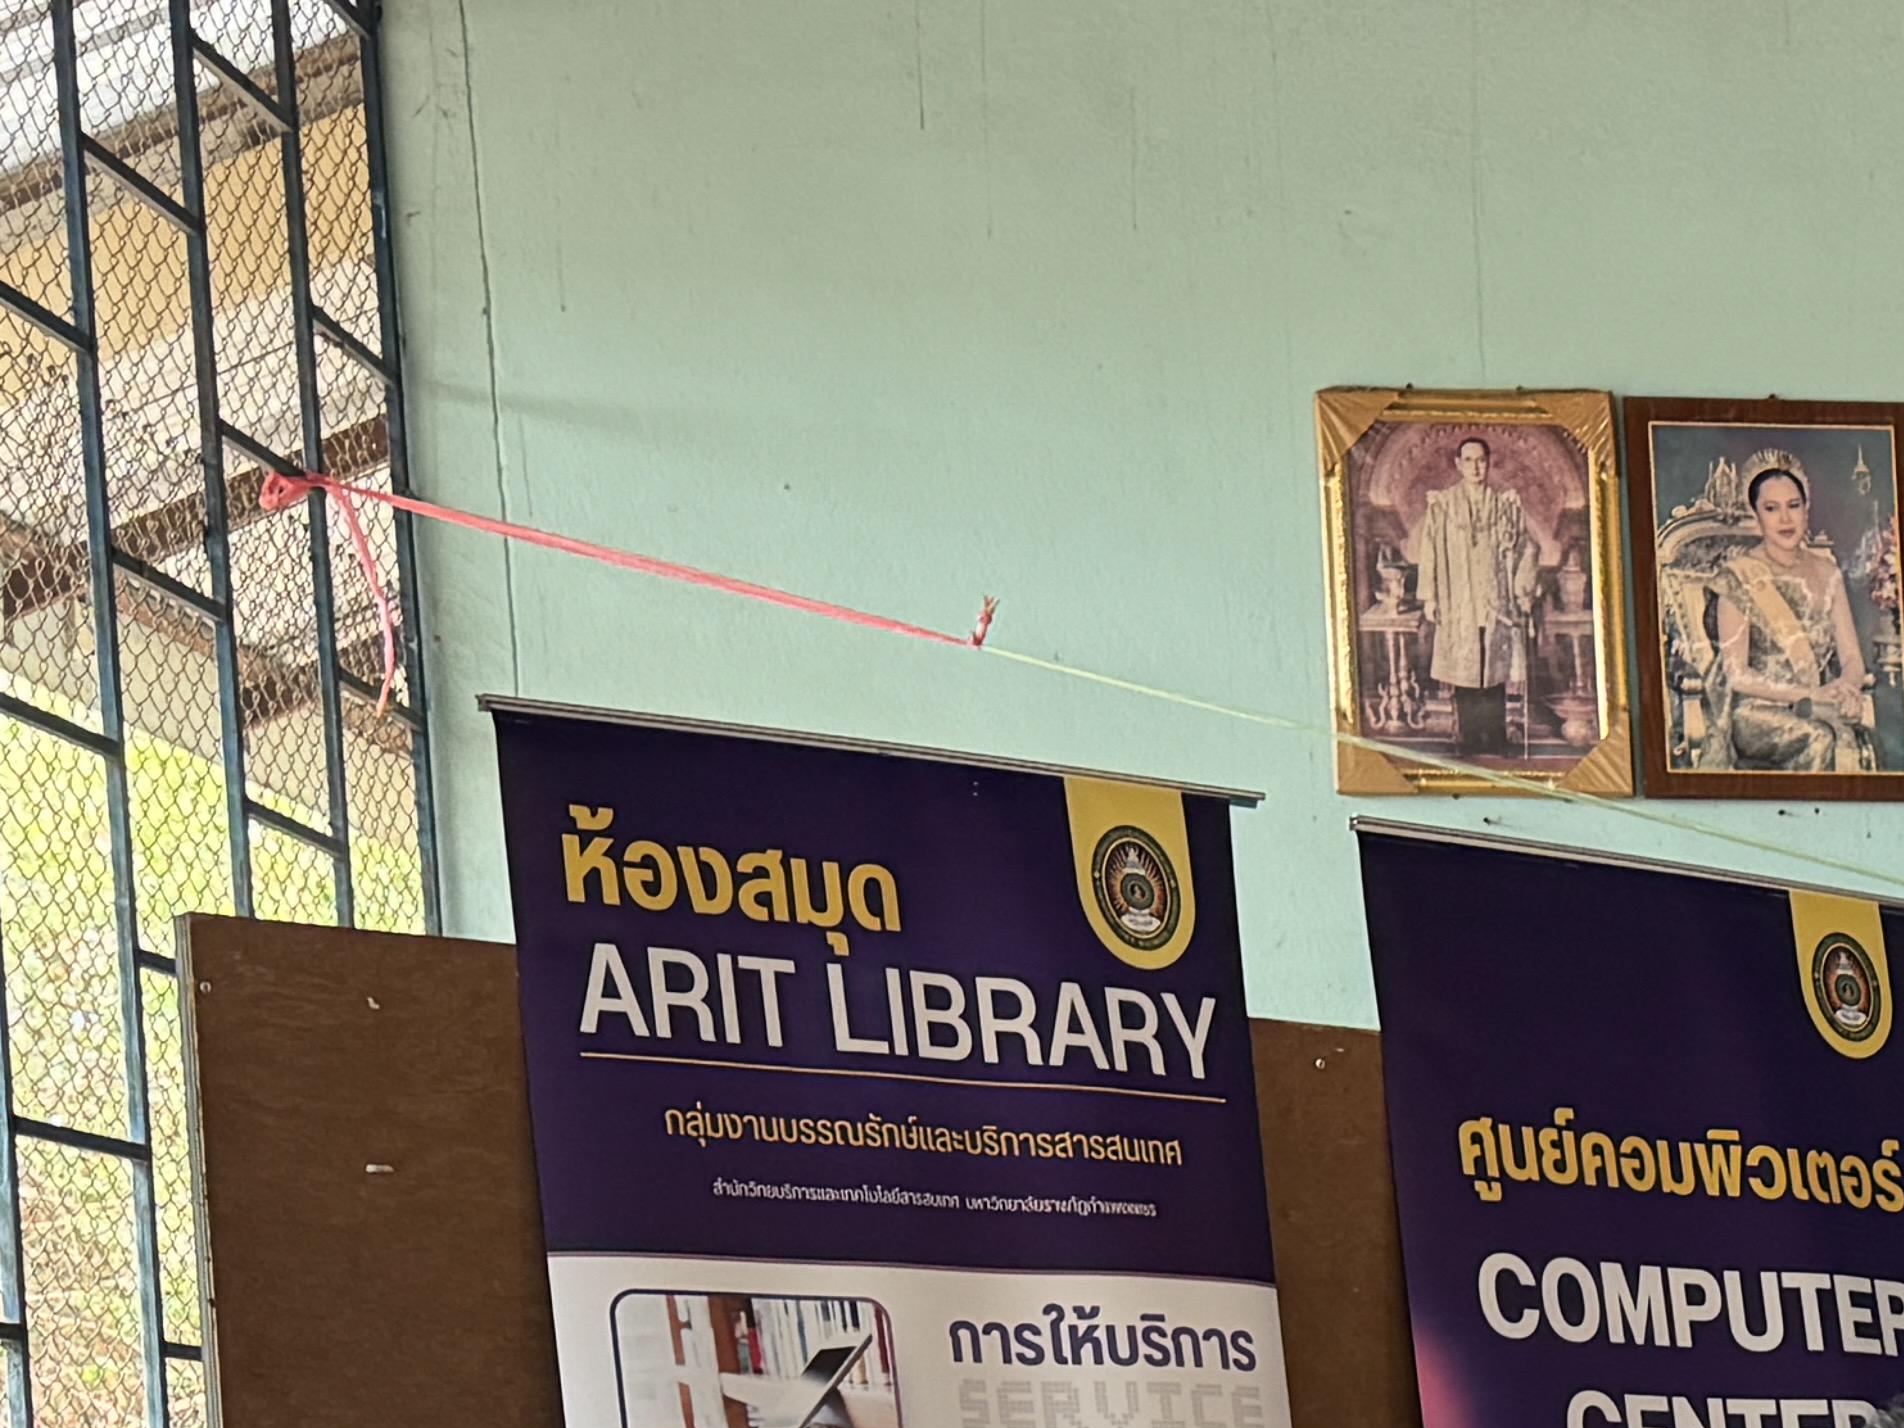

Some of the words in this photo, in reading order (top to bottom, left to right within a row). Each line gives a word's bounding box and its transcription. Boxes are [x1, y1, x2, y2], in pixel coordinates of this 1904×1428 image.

[560, 804, 901, 955] ห้องสมุด
[580, 944, 796, 1047] ARIT
[828, 961, 1216, 1080] LIBRARY
[664, 1100, 1183, 1165] กลุ่มงานบรรณรักษ์และบริการสารสนเทศ
[950, 1302, 1256, 1372] การให้บริการ
